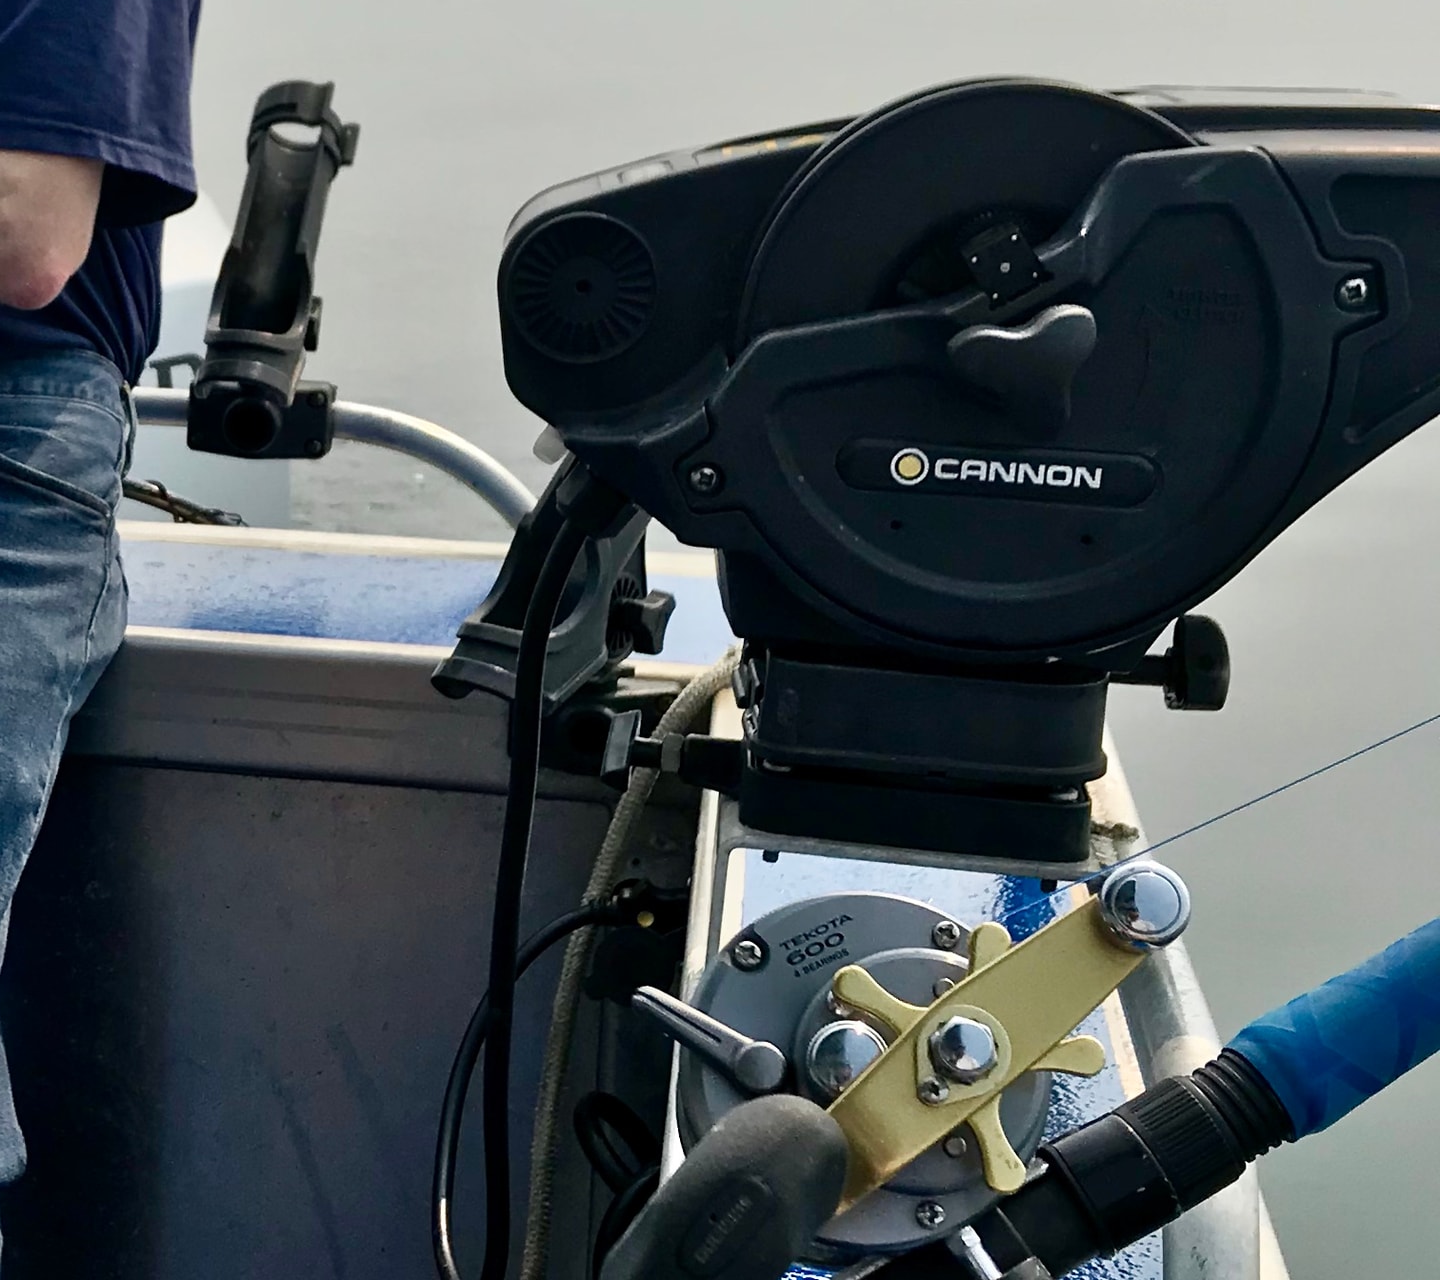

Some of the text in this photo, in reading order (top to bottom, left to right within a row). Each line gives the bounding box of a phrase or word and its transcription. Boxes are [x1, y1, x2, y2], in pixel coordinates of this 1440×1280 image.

[935, 458, 1102, 488] CANNON
[779, 914, 853, 950] TEKOTA
[786, 932, 845, 966] 600
[802, 948, 850, 974] BEARINGS
